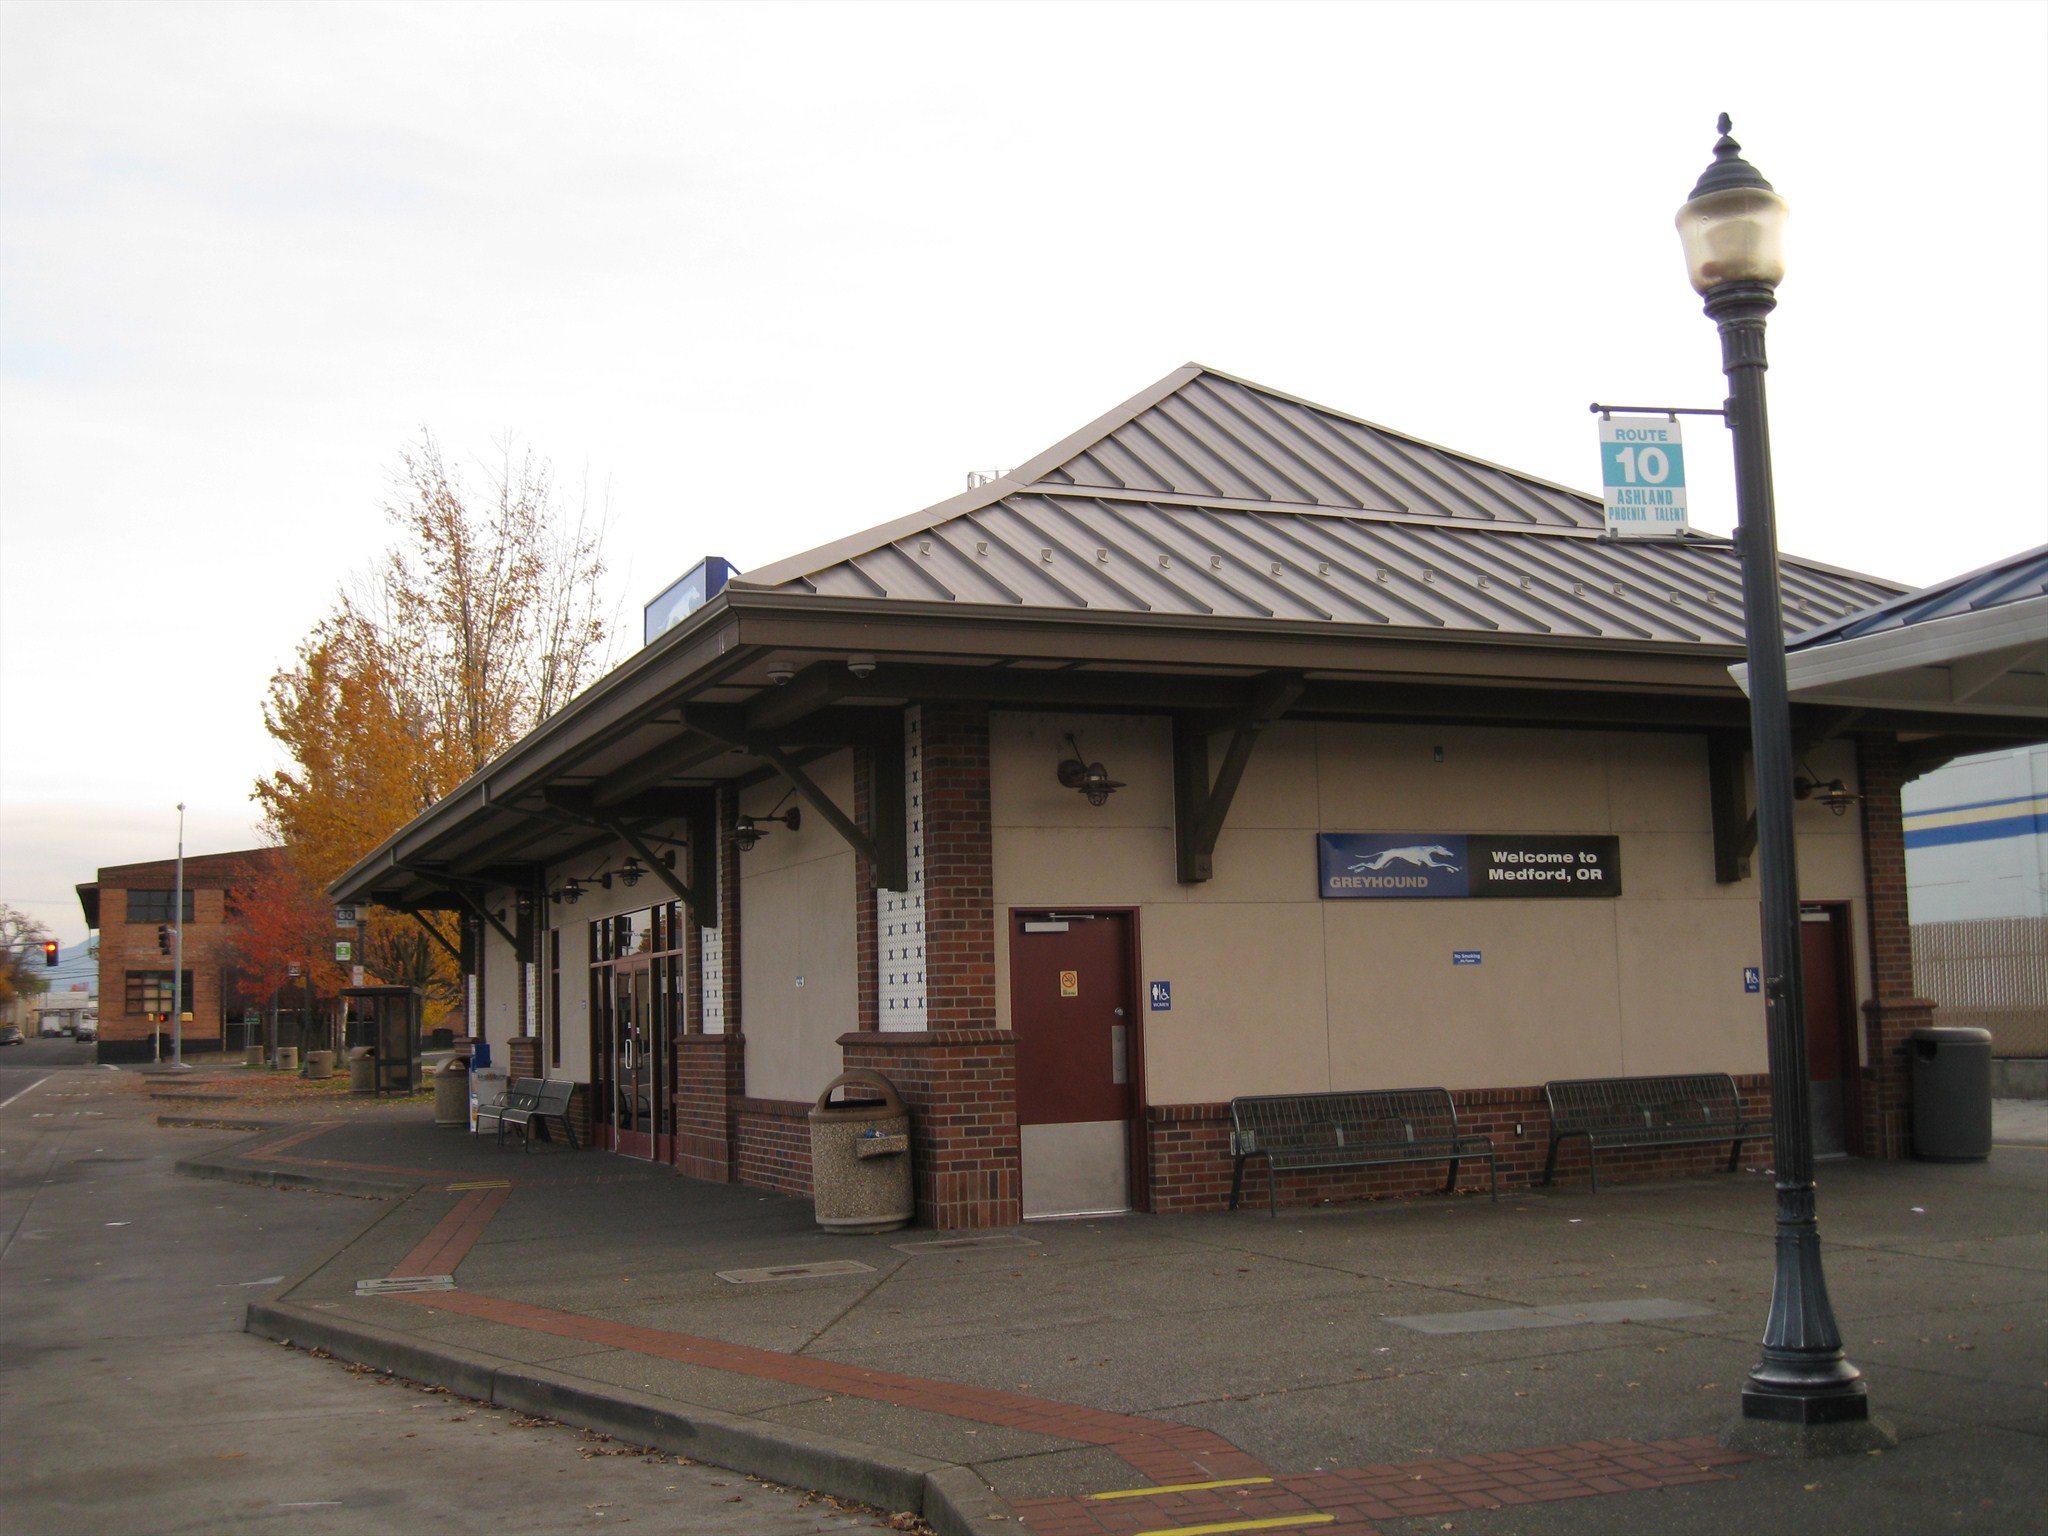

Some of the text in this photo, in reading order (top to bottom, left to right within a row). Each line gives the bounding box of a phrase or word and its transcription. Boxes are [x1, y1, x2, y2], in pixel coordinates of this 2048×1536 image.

[1615, 429, 1668, 441] ROUTE
[1615, 446, 1670, 484] 10
[1617, 489, 1673, 505] ASHLAND
[1608, 507, 1686, 520] PHOENIX TALENT
[1491, 851, 1598, 863] Welcome to
[1488, 868, 1602, 882] Medford, OR
[1329, 876, 1428, 888] GREYHOUND
[338, 911, 354, 920] 60
